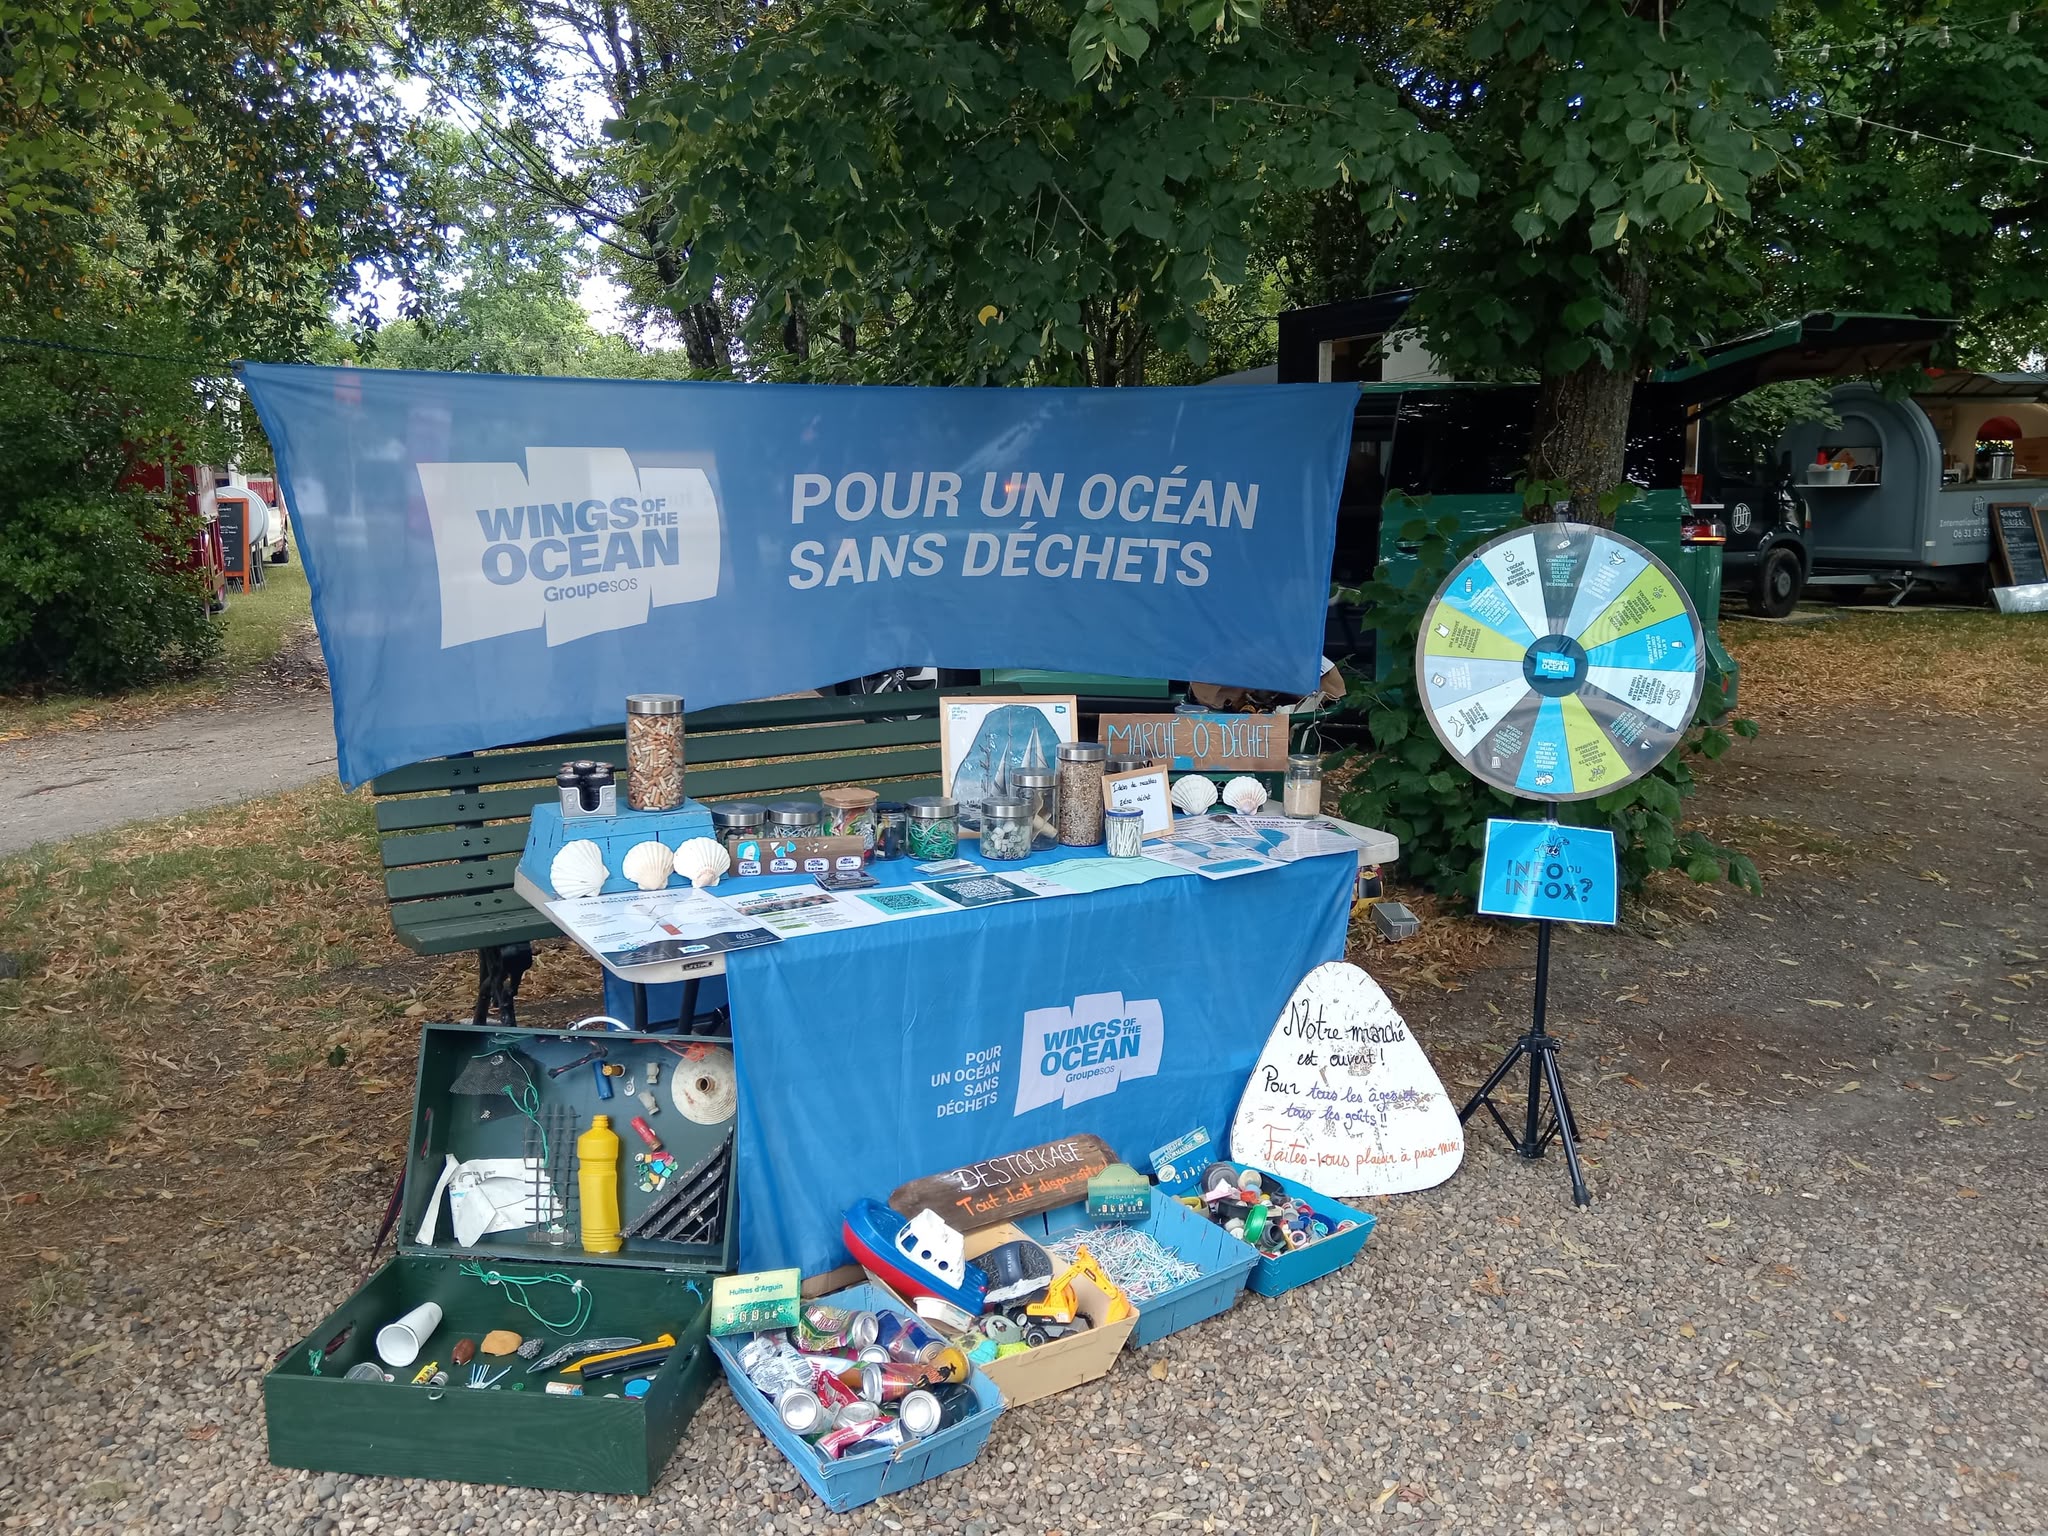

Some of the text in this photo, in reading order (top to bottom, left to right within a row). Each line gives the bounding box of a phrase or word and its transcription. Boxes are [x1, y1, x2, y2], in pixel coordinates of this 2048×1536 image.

[792, 465, 1259, 529] POUR UN OCÉAN
[476, 497, 666, 542] WINGS OF
[642, 512, 678, 527] THE
[1953, 530, 1961, 538] 06
[1974, 528, 1980, 537] 87
[482, 527, 679, 586] OCEAN
[789, 522, 1212, 590] SANS DÉCHETS
[1542, 664, 1569, 672] OCEAN
[1108, 718, 1181, 759] MARCHÉ
[1219, 718, 1274, 759] DÉCHET
[1507, 860, 1563, 880] INFO
[1044, 1017, 1136, 1052] WINGS OF
[1122, 1024, 1142, 1035] THE
[1284, 999, 1405, 1043] Notre marché
[966, 1046, 1001, 1066] POUR
[1040, 1034, 1141, 1076] OCEAN
[1297, 1051, 1318, 1066] est
[1330, 1052, 1377, 1067] ouvert
[931, 1060, 1000, 1087] UN OCÉAN
[964, 1076, 999, 1097] SANS
[1262, 1065, 1300, 1094] Pour
[1306, 1082, 1338, 1100] tous
[1340, 1087, 1363, 1103] les
[1368, 1088, 1397, 1112] âges
[936, 1092, 997, 1118] DÉCHETS
[1282, 1103, 1312, 1120] tous
[1319, 1106, 1340, 1121] les
[1344, 1110, 1376, 1130] goûts
[1263, 1124, 1349, 1167] Faites-vous
[1356, 1150, 1398, 1175] plaisir
[1400, 1148, 1410, 1162] à
[1414, 1148, 1436, 1168] prix
[951, 1142, 1084, 1190] DESTOCKAGE
[956, 1195, 1000, 1216] Tout
[1008, 1184, 1035, 1204] doit
[755, 1283, 783, 1292] d'Arguin
